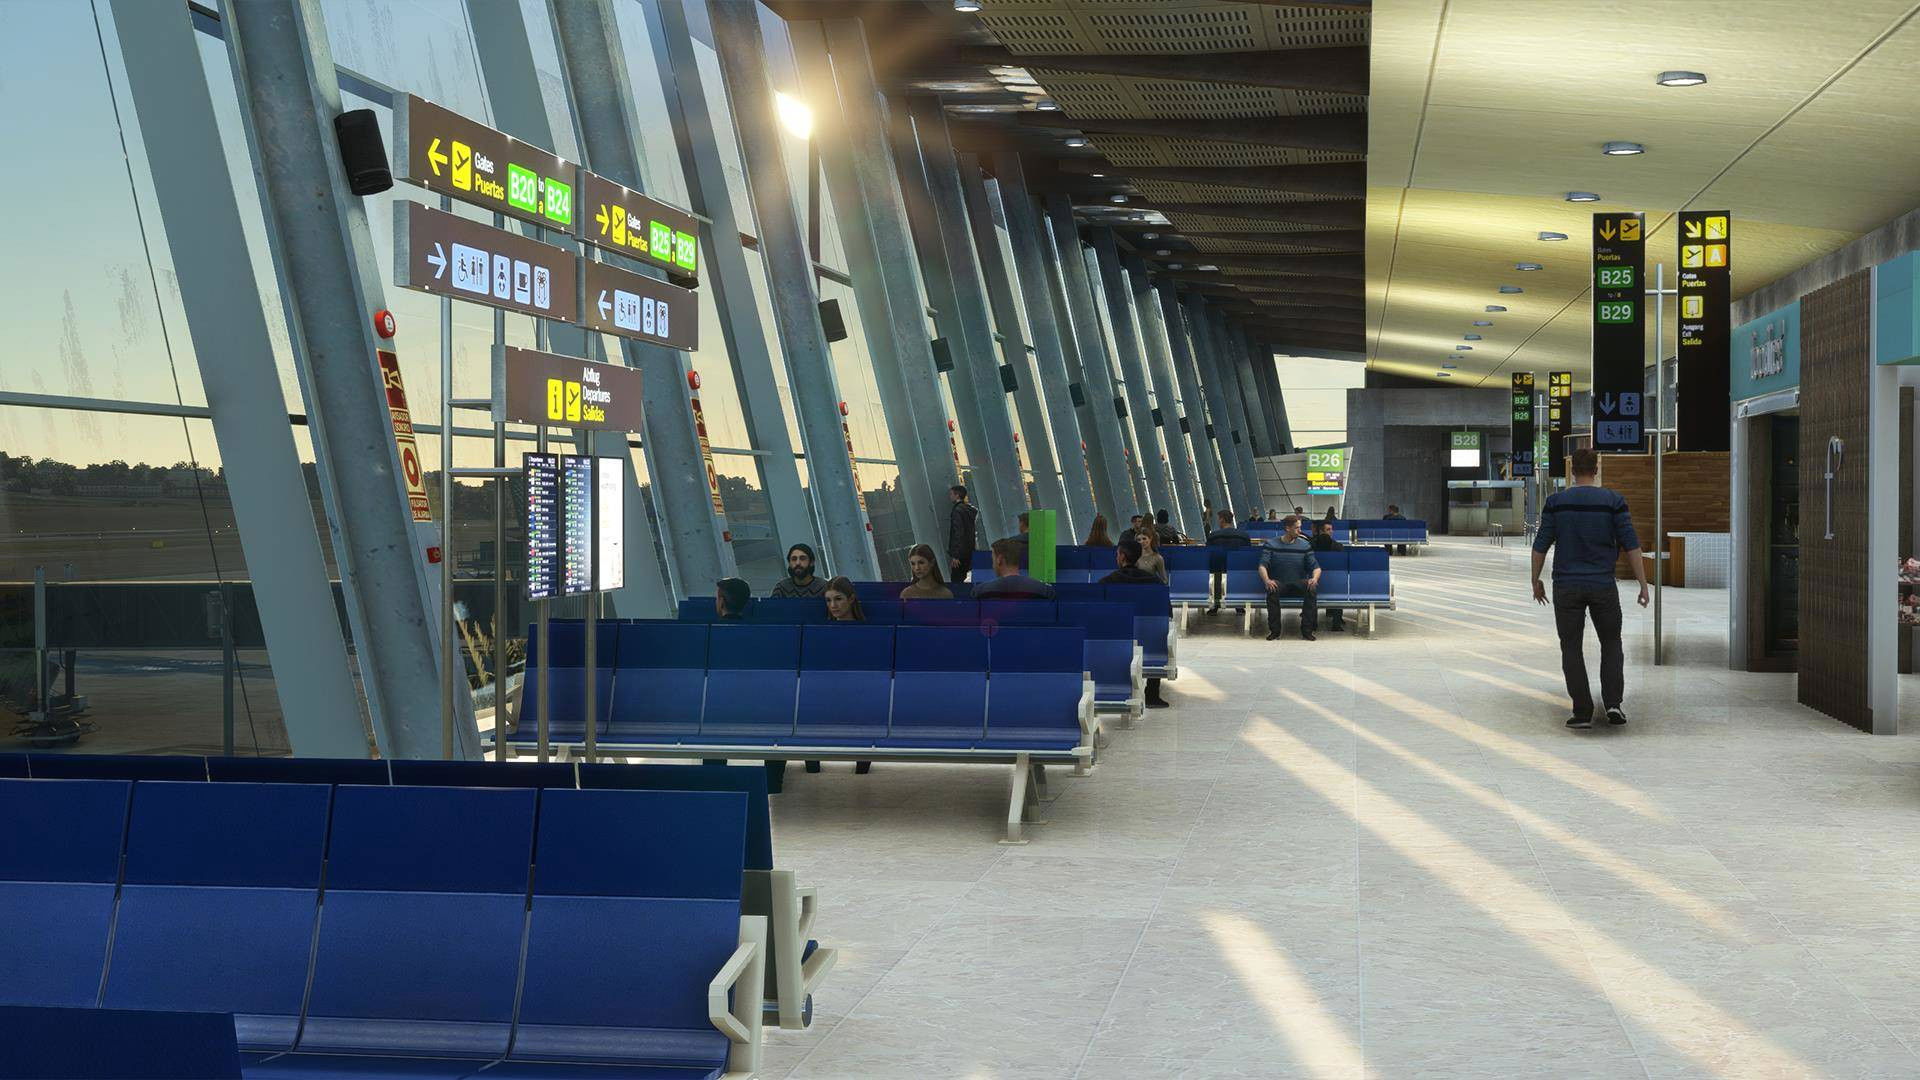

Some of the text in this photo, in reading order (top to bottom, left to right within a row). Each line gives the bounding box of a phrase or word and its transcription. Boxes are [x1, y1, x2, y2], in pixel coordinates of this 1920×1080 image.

[475, 151, 494, 174] Gates
[475, 172, 504, 200] Puertas
[511, 171, 536, 206] B20
[538, 176, 545, 193] to
[538, 200, 544, 214] a
[548, 185, 570, 217] B24
[627, 212, 641, 231] Gates
[627, 230, 648, 252] Puertas
[651, 226, 670, 254] B25
[677, 237, 696, 264] B29
[1597, 253, 1621, 261] Puertas
[1601, 269, 1631, 285] B25
[1601, 305, 1631, 320] B29
[583, 367, 600, 386] Abflug
[583, 385, 611, 404] Departures
[583, 404, 605, 422] Salidas
[1453, 434, 1478, 446] B28
[1309, 453, 1341, 467] B26
